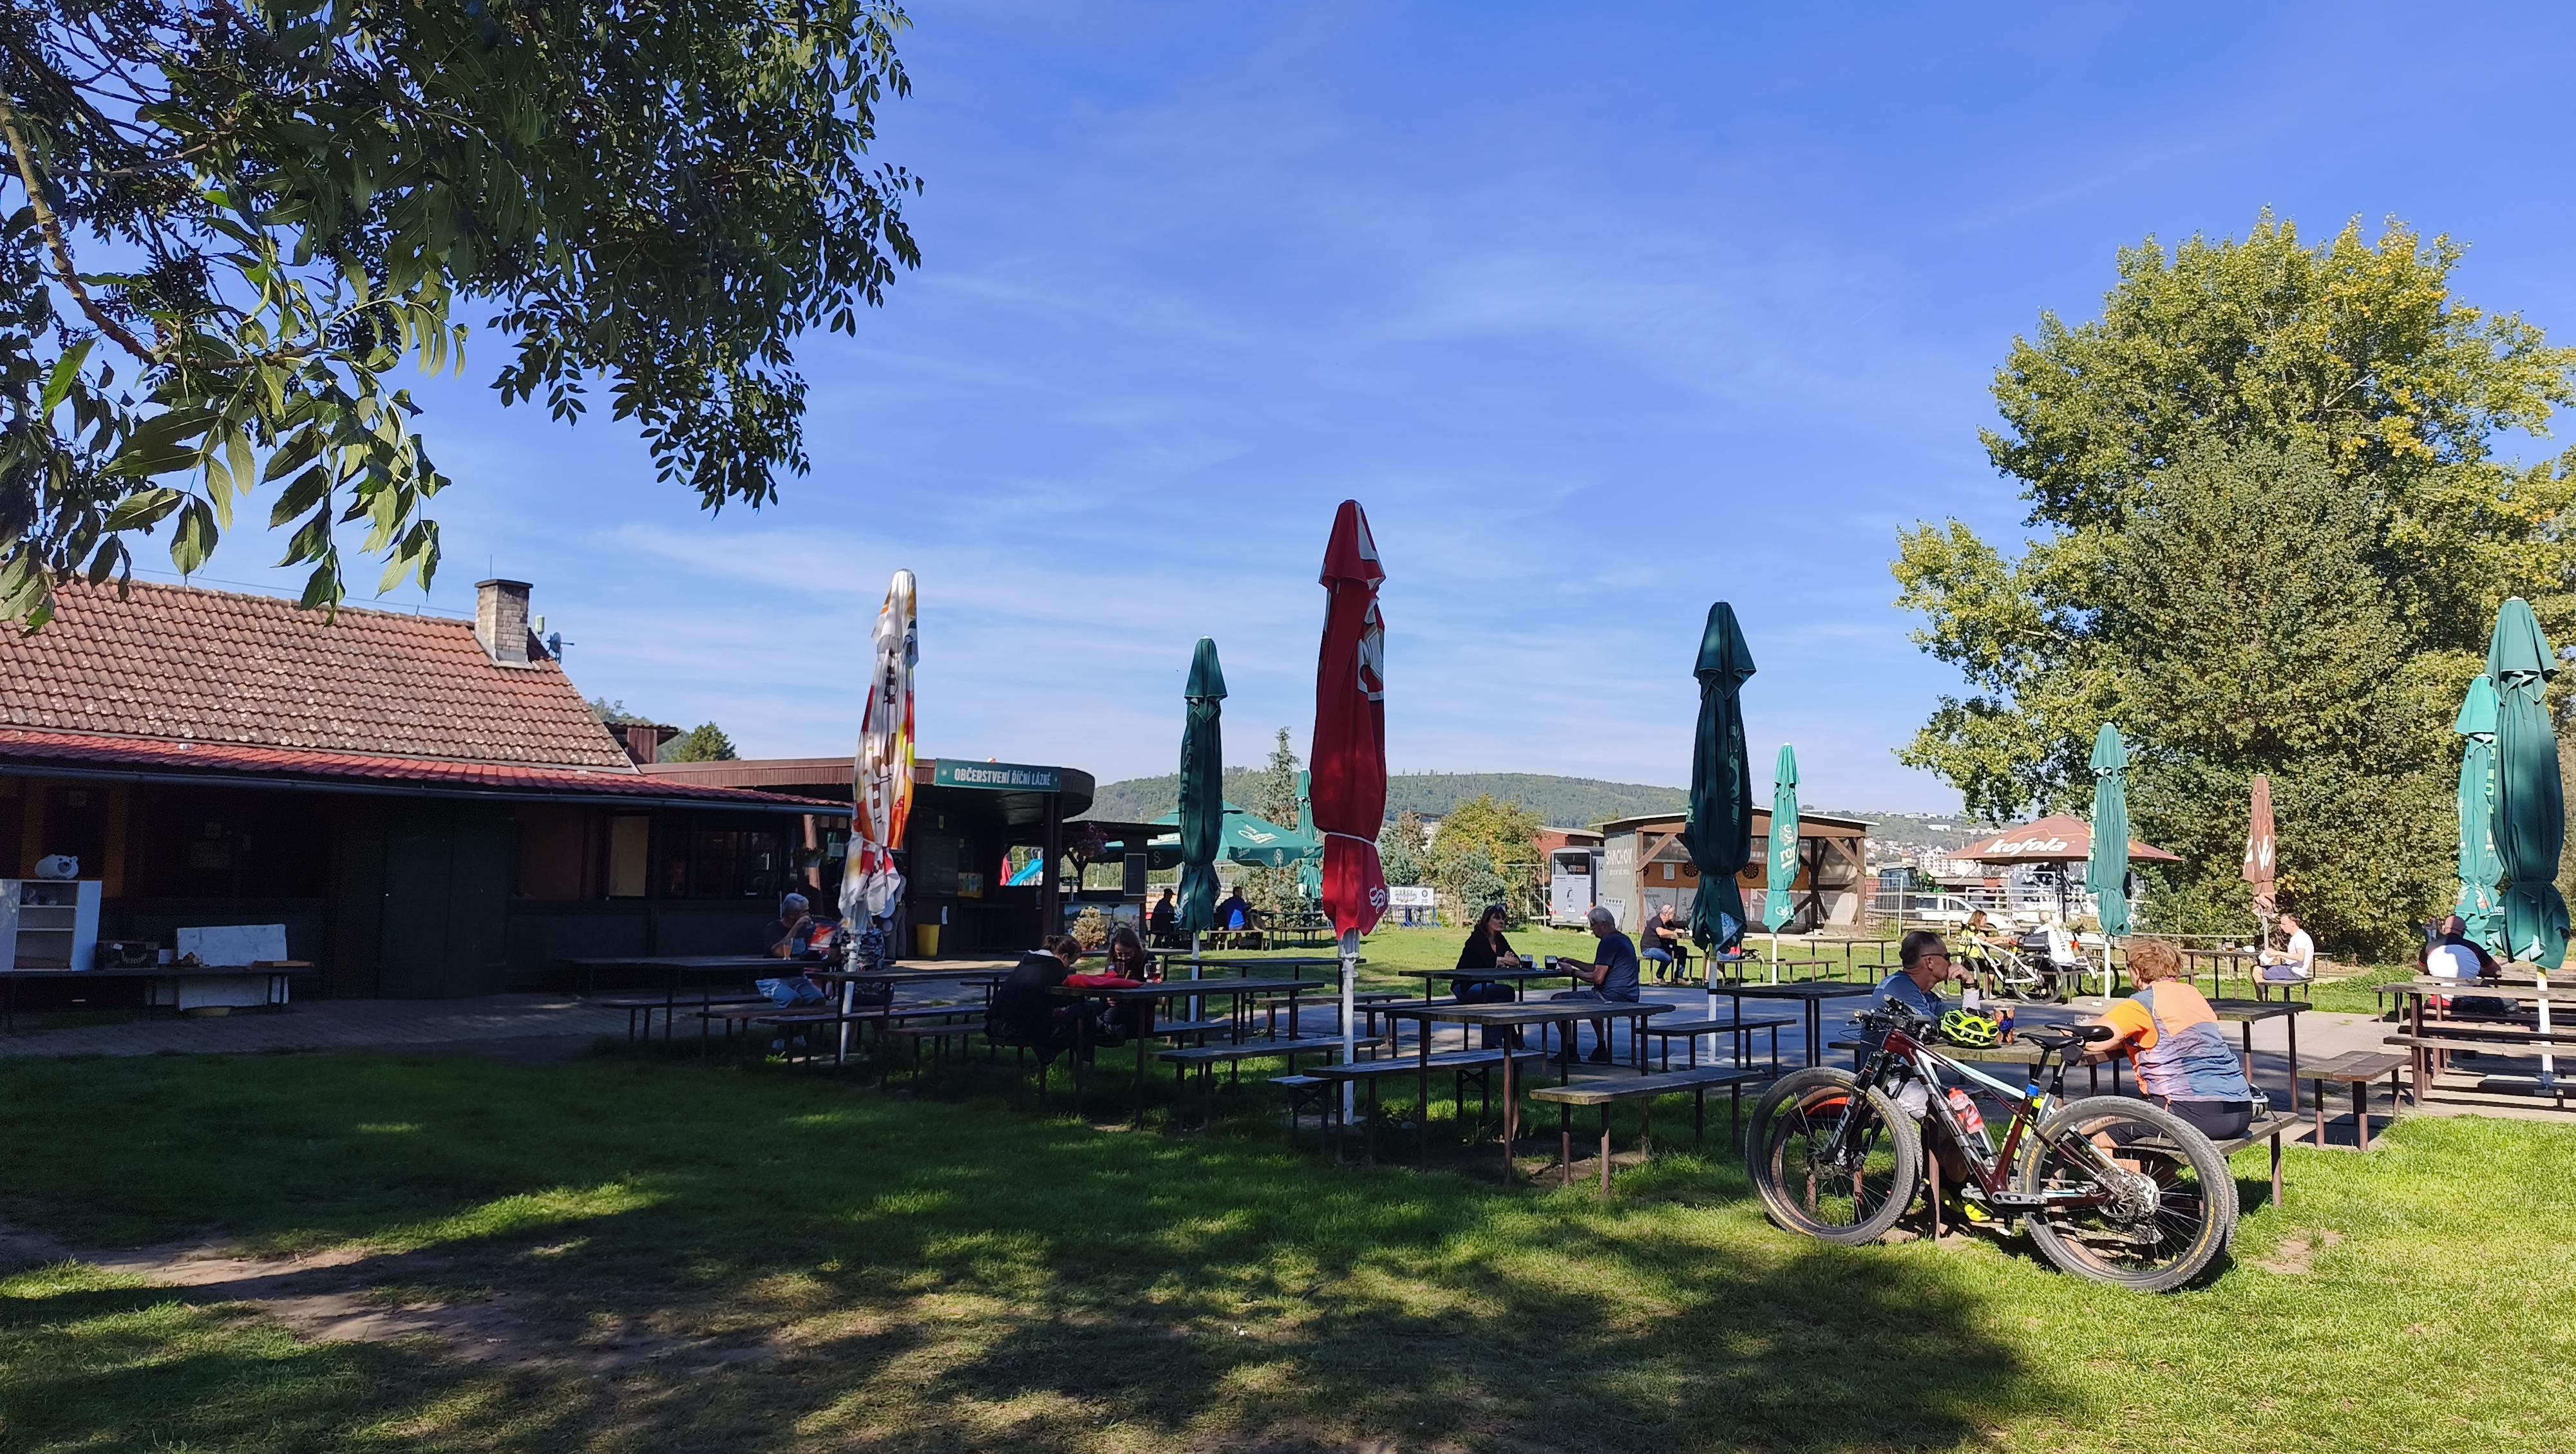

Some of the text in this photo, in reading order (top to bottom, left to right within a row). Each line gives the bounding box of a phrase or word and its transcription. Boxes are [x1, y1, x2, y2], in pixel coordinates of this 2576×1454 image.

[954, 767, 1051, 786] OBČERSTVENÍ ŘÍČNÍ LÁZNĚ
[1984, 837, 2068, 856] kofola
